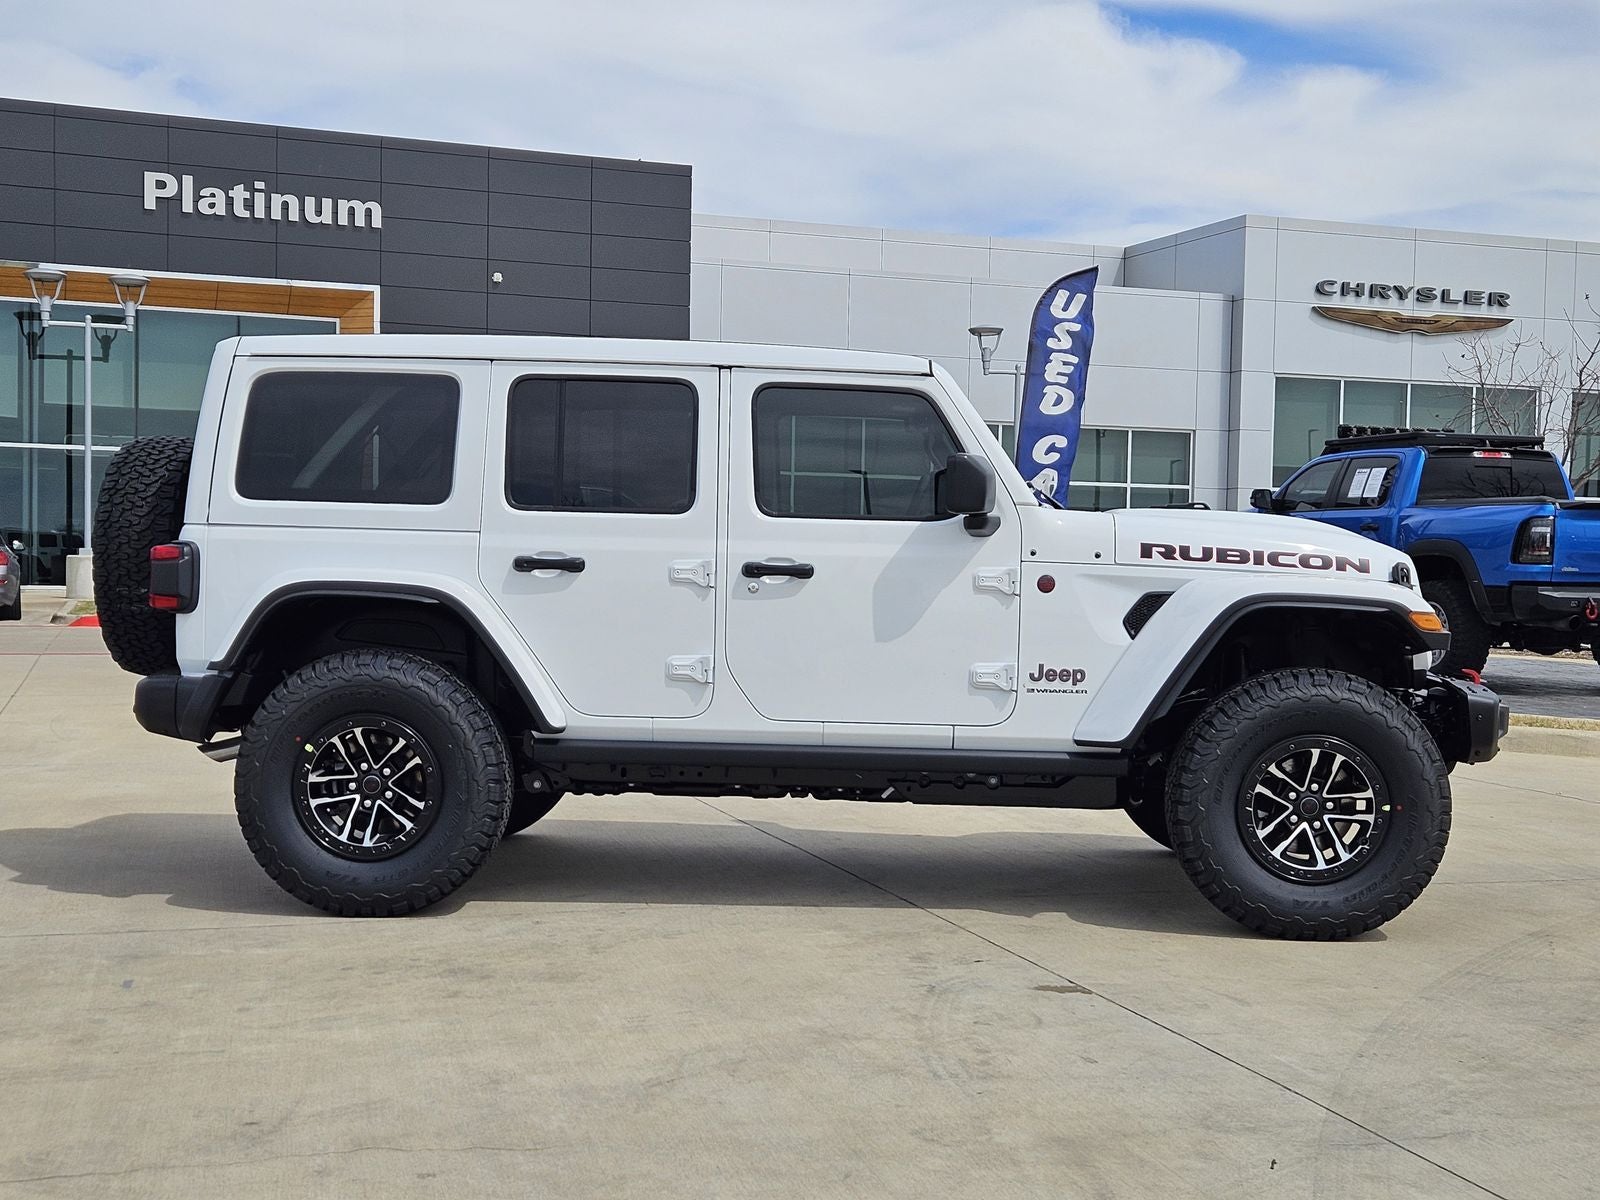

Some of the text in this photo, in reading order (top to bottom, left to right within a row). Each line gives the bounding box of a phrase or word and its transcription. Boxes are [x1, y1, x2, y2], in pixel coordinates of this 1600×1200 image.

[143, 171, 382, 229] Platinum
[1315, 279, 1511, 308] CHRYSLER
[1039, 289, 1087, 415] USED
[1139, 542, 1371, 574] RUBICON
[1028, 663, 1086, 686] Jeep
